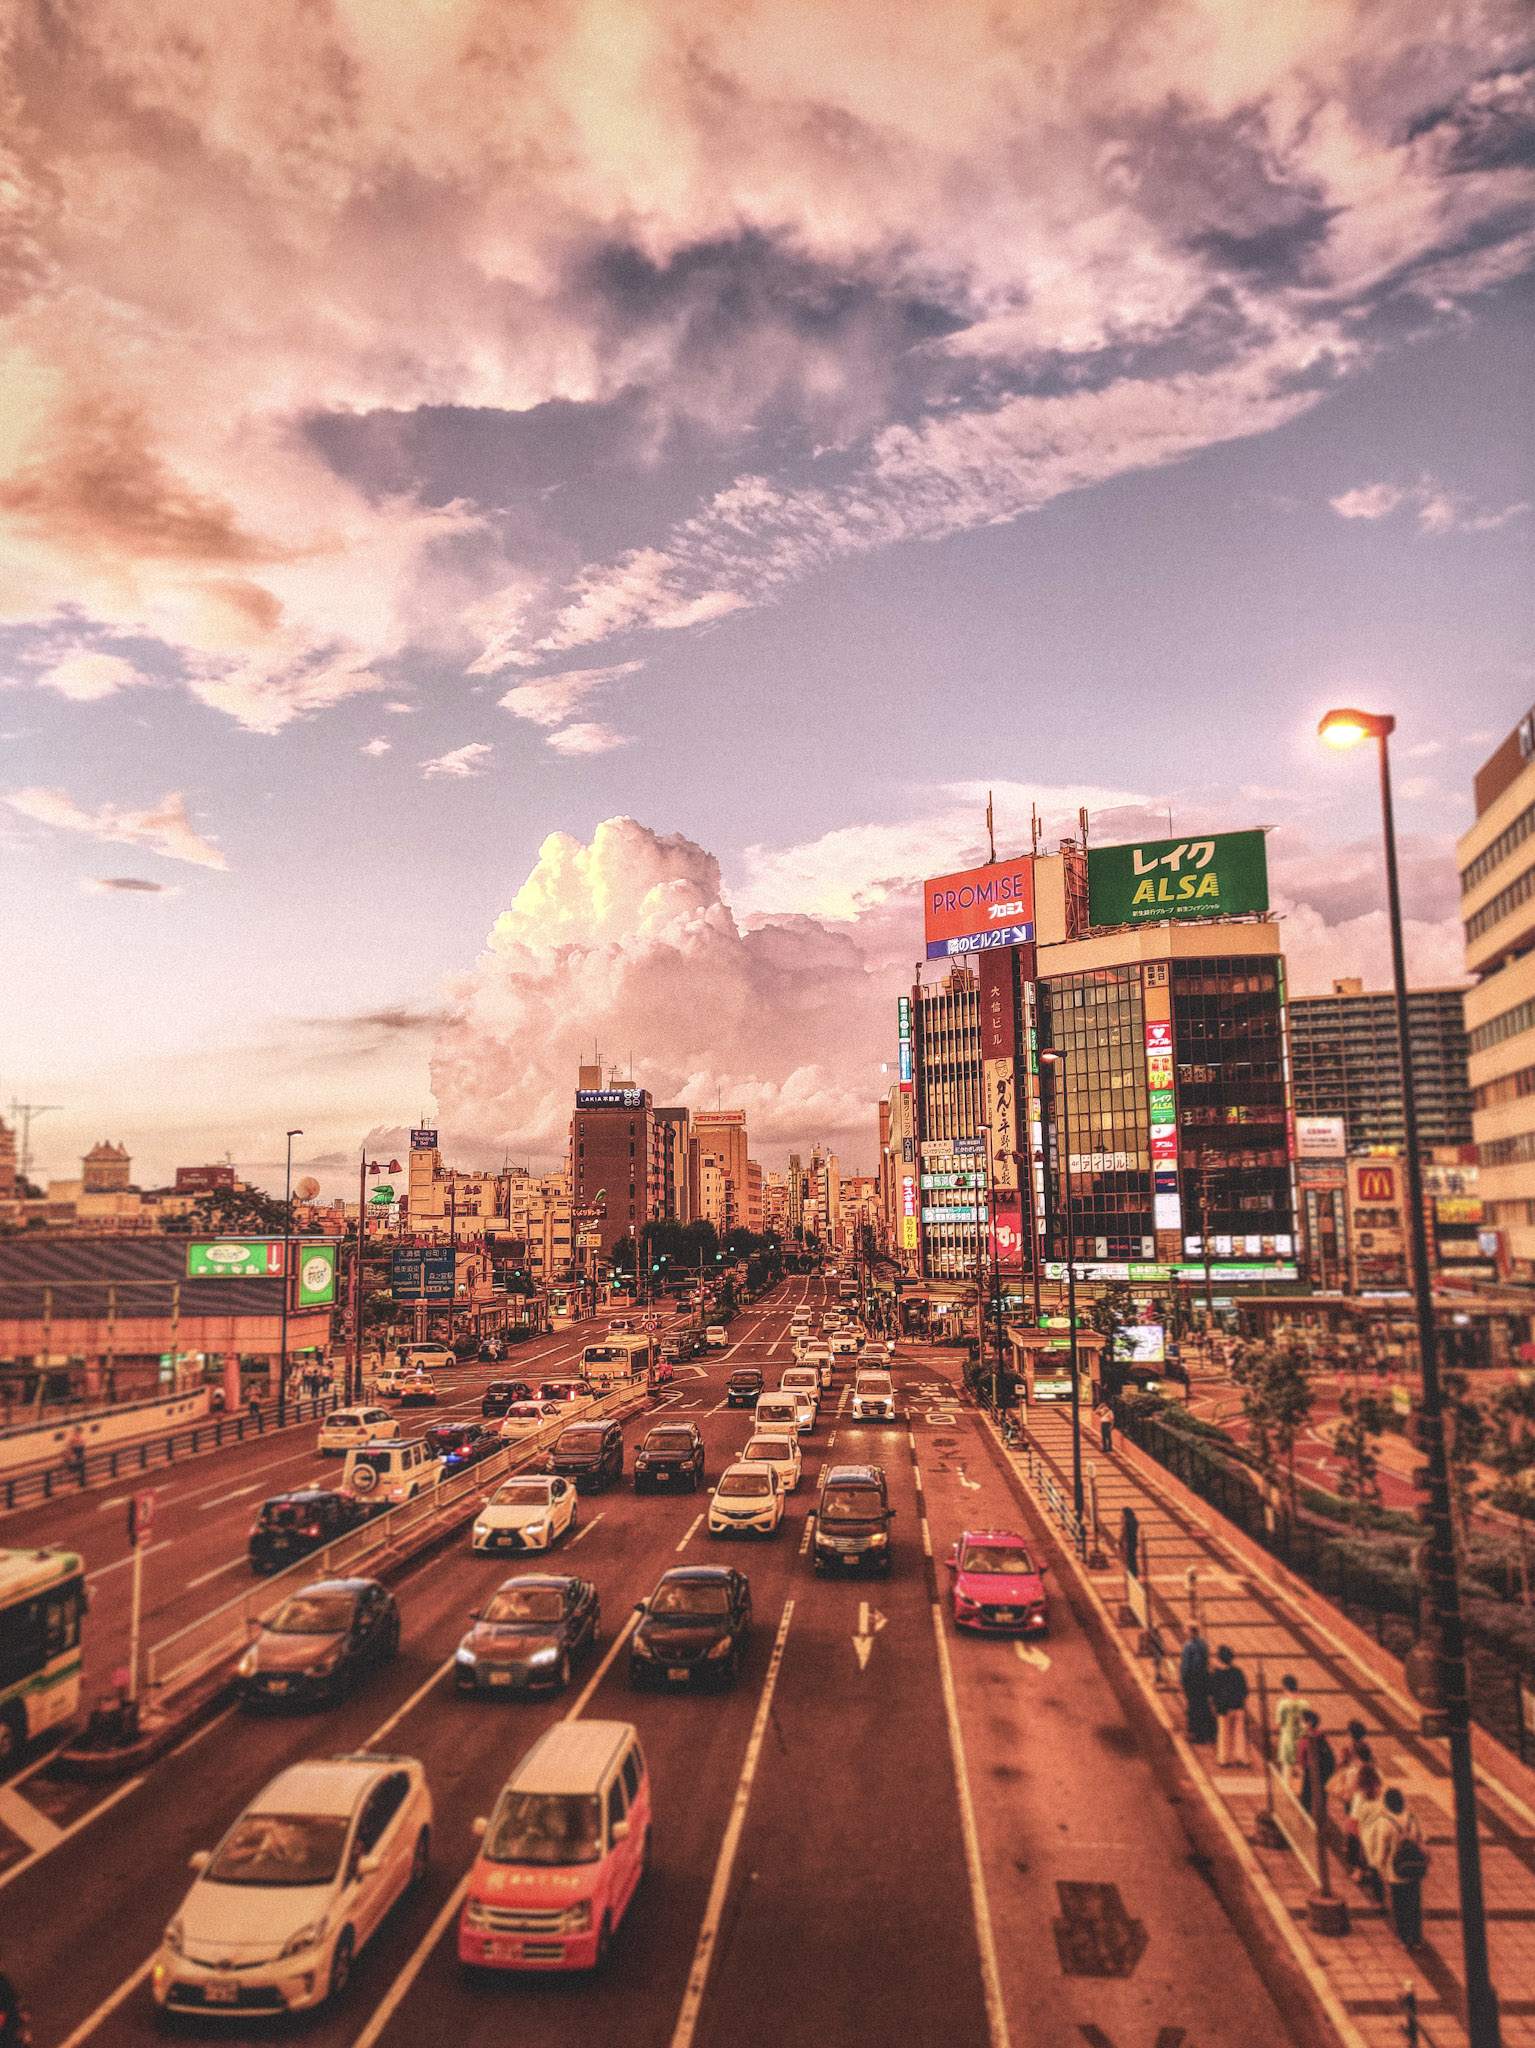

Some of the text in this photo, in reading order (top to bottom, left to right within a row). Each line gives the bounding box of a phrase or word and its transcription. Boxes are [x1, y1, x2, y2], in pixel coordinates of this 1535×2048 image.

[1133, 841, 1215, 875] レイク
[933, 873, 1022, 914] PROMISE
[1132, 873, 1219, 904] ALSA
[988, 901, 1024, 919] プロミス
[947, 928, 1011, 955] 隣のビル2F
[991, 986, 1003, 1045] 大信ビル
[1152, 1095, 1172, 1103] レイク
[1082, 1159, 1125, 1169] アイフル
